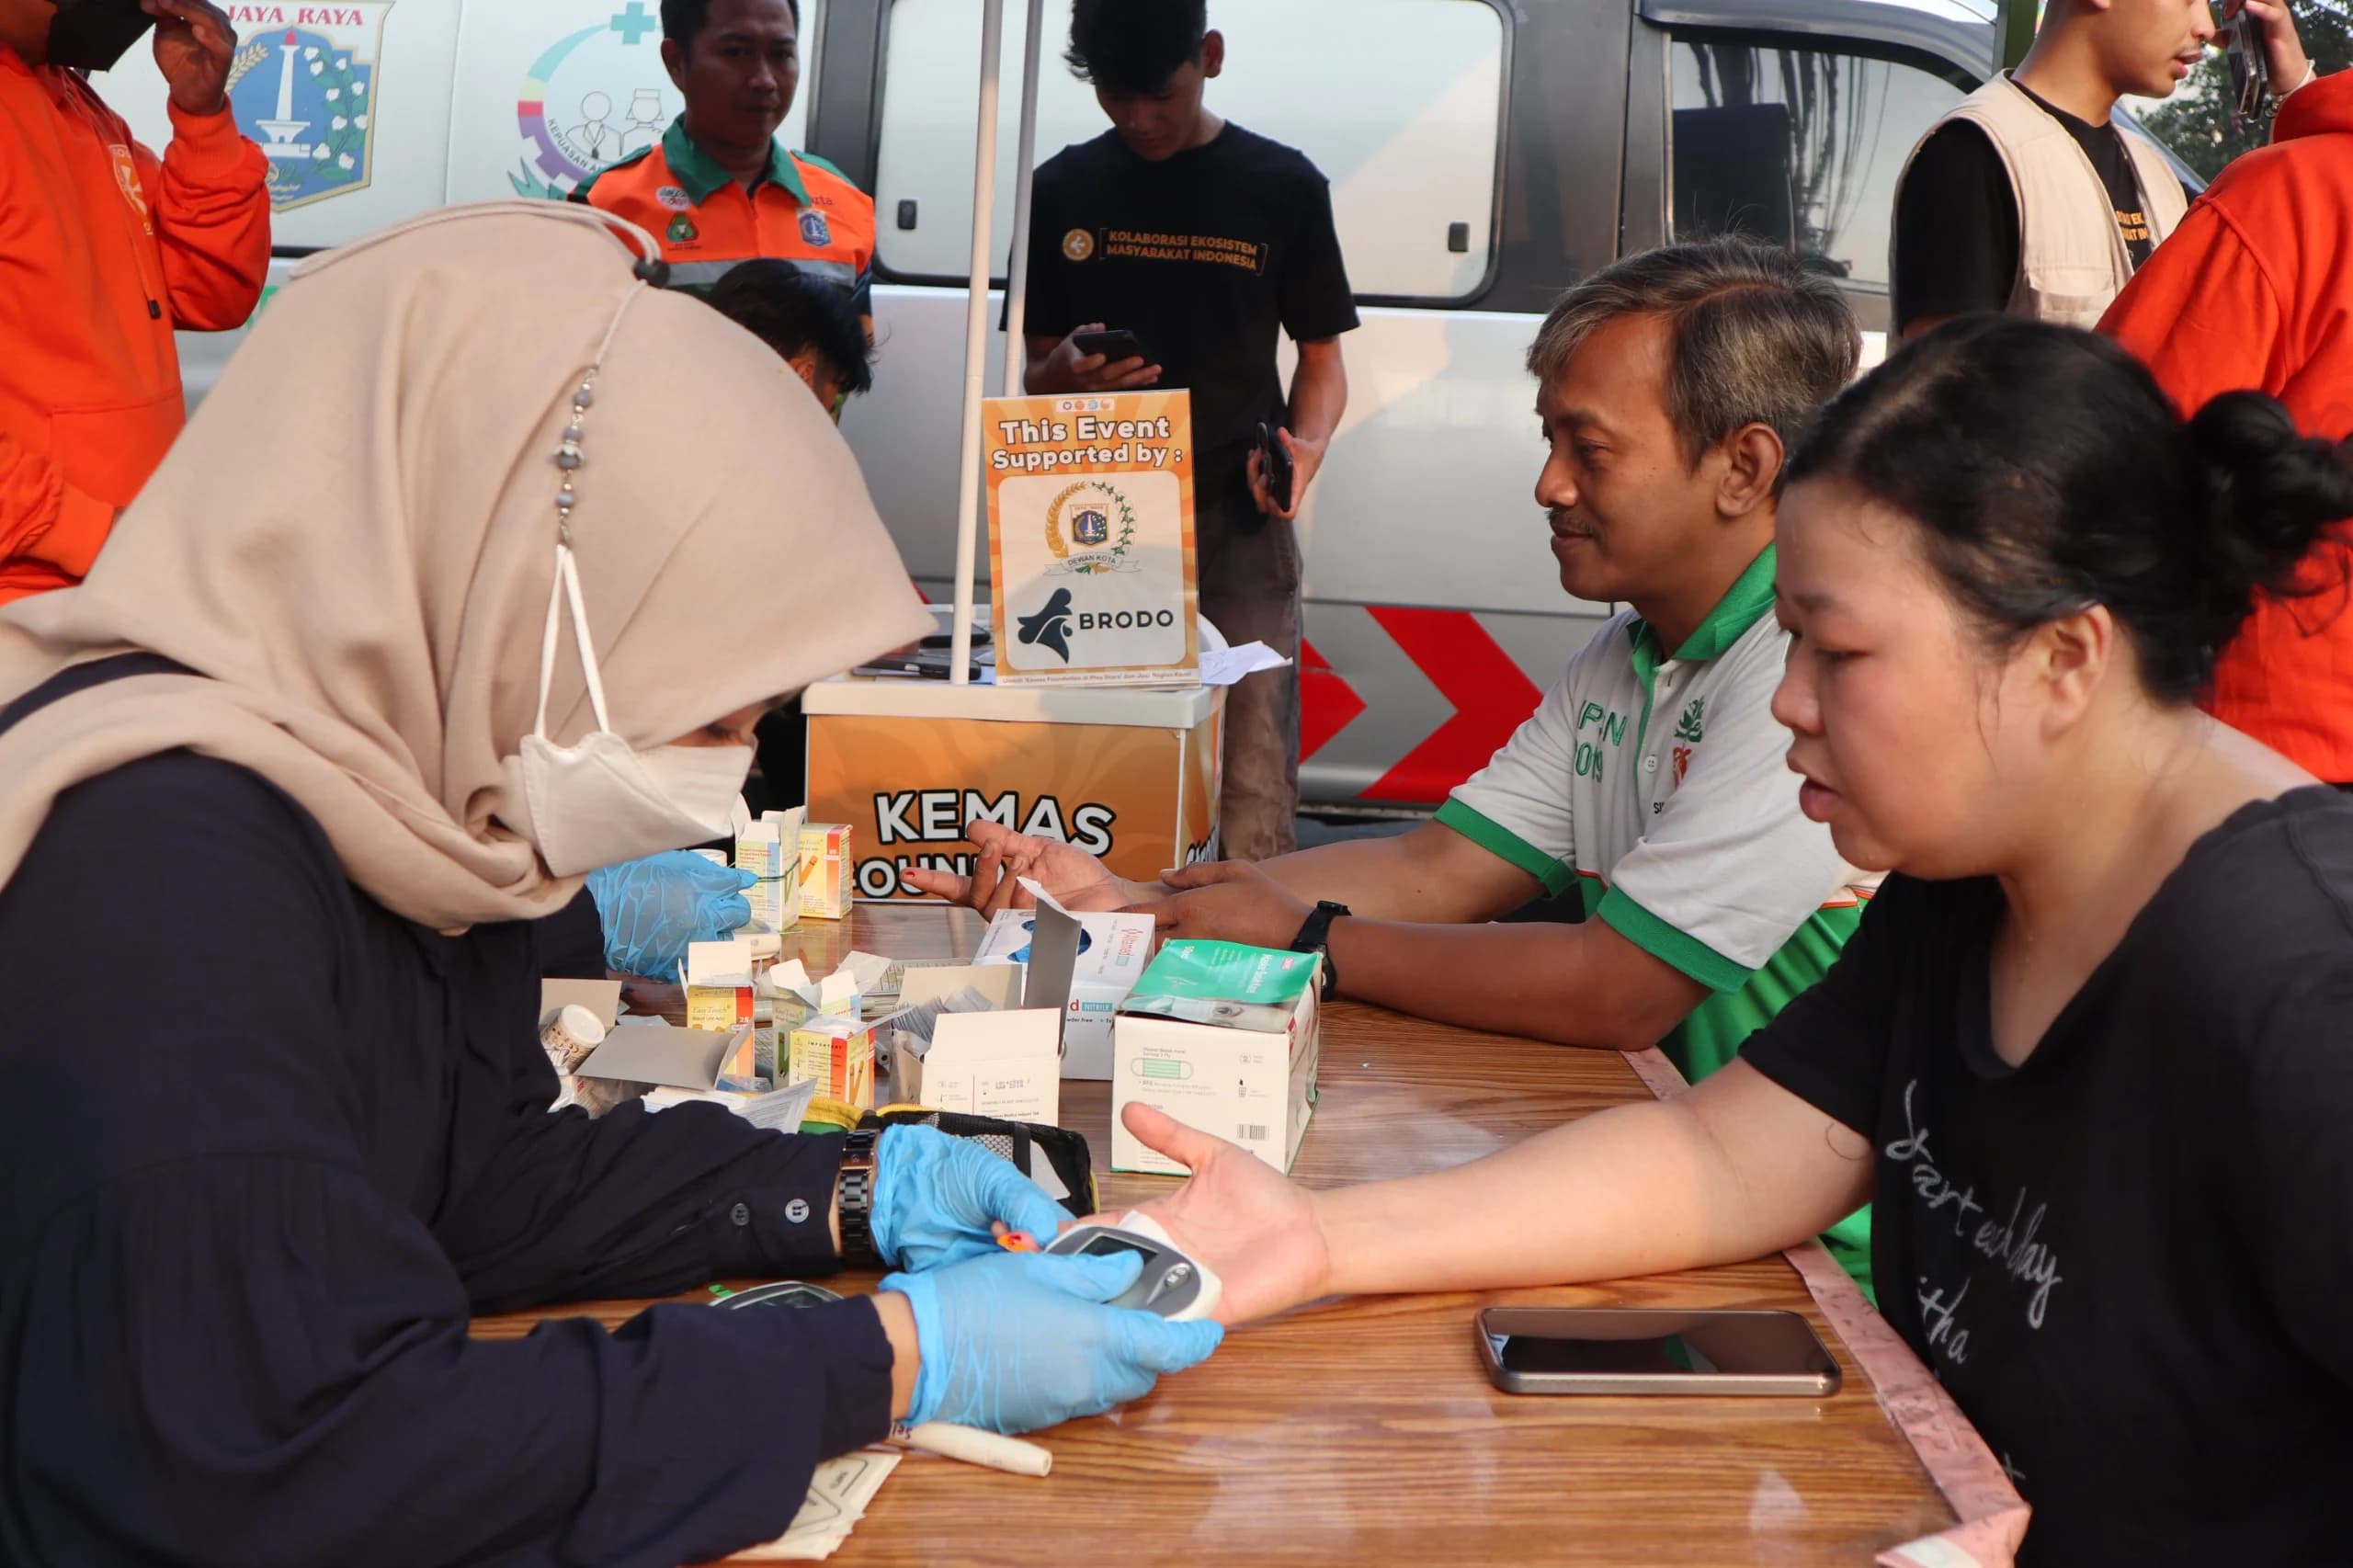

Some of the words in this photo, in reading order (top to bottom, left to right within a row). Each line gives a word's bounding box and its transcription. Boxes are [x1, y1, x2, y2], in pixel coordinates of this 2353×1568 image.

[229, 6, 283, 23] JAYA
[296, 8, 364, 26] RAYA
[1109, 230, 1188, 246] KOLABORASI
[1191, 235, 1258, 256] EKOSISTEM
[1107, 244, 1190, 260] MASYARAKAT
[1193, 249, 1256, 270] INDONESIA
[999, 418, 1068, 445] This
[1076, 415, 1171, 441] Event
[992, 443, 1130, 472] Supported
[1136, 443, 1168, 468] by
[1067, 554, 1095, 566] DEWAN
[1096, 554, 1117, 564] KOTA
[1078, 608, 1175, 631] BRODO
[874, 789, 1117, 858] KEMAS
